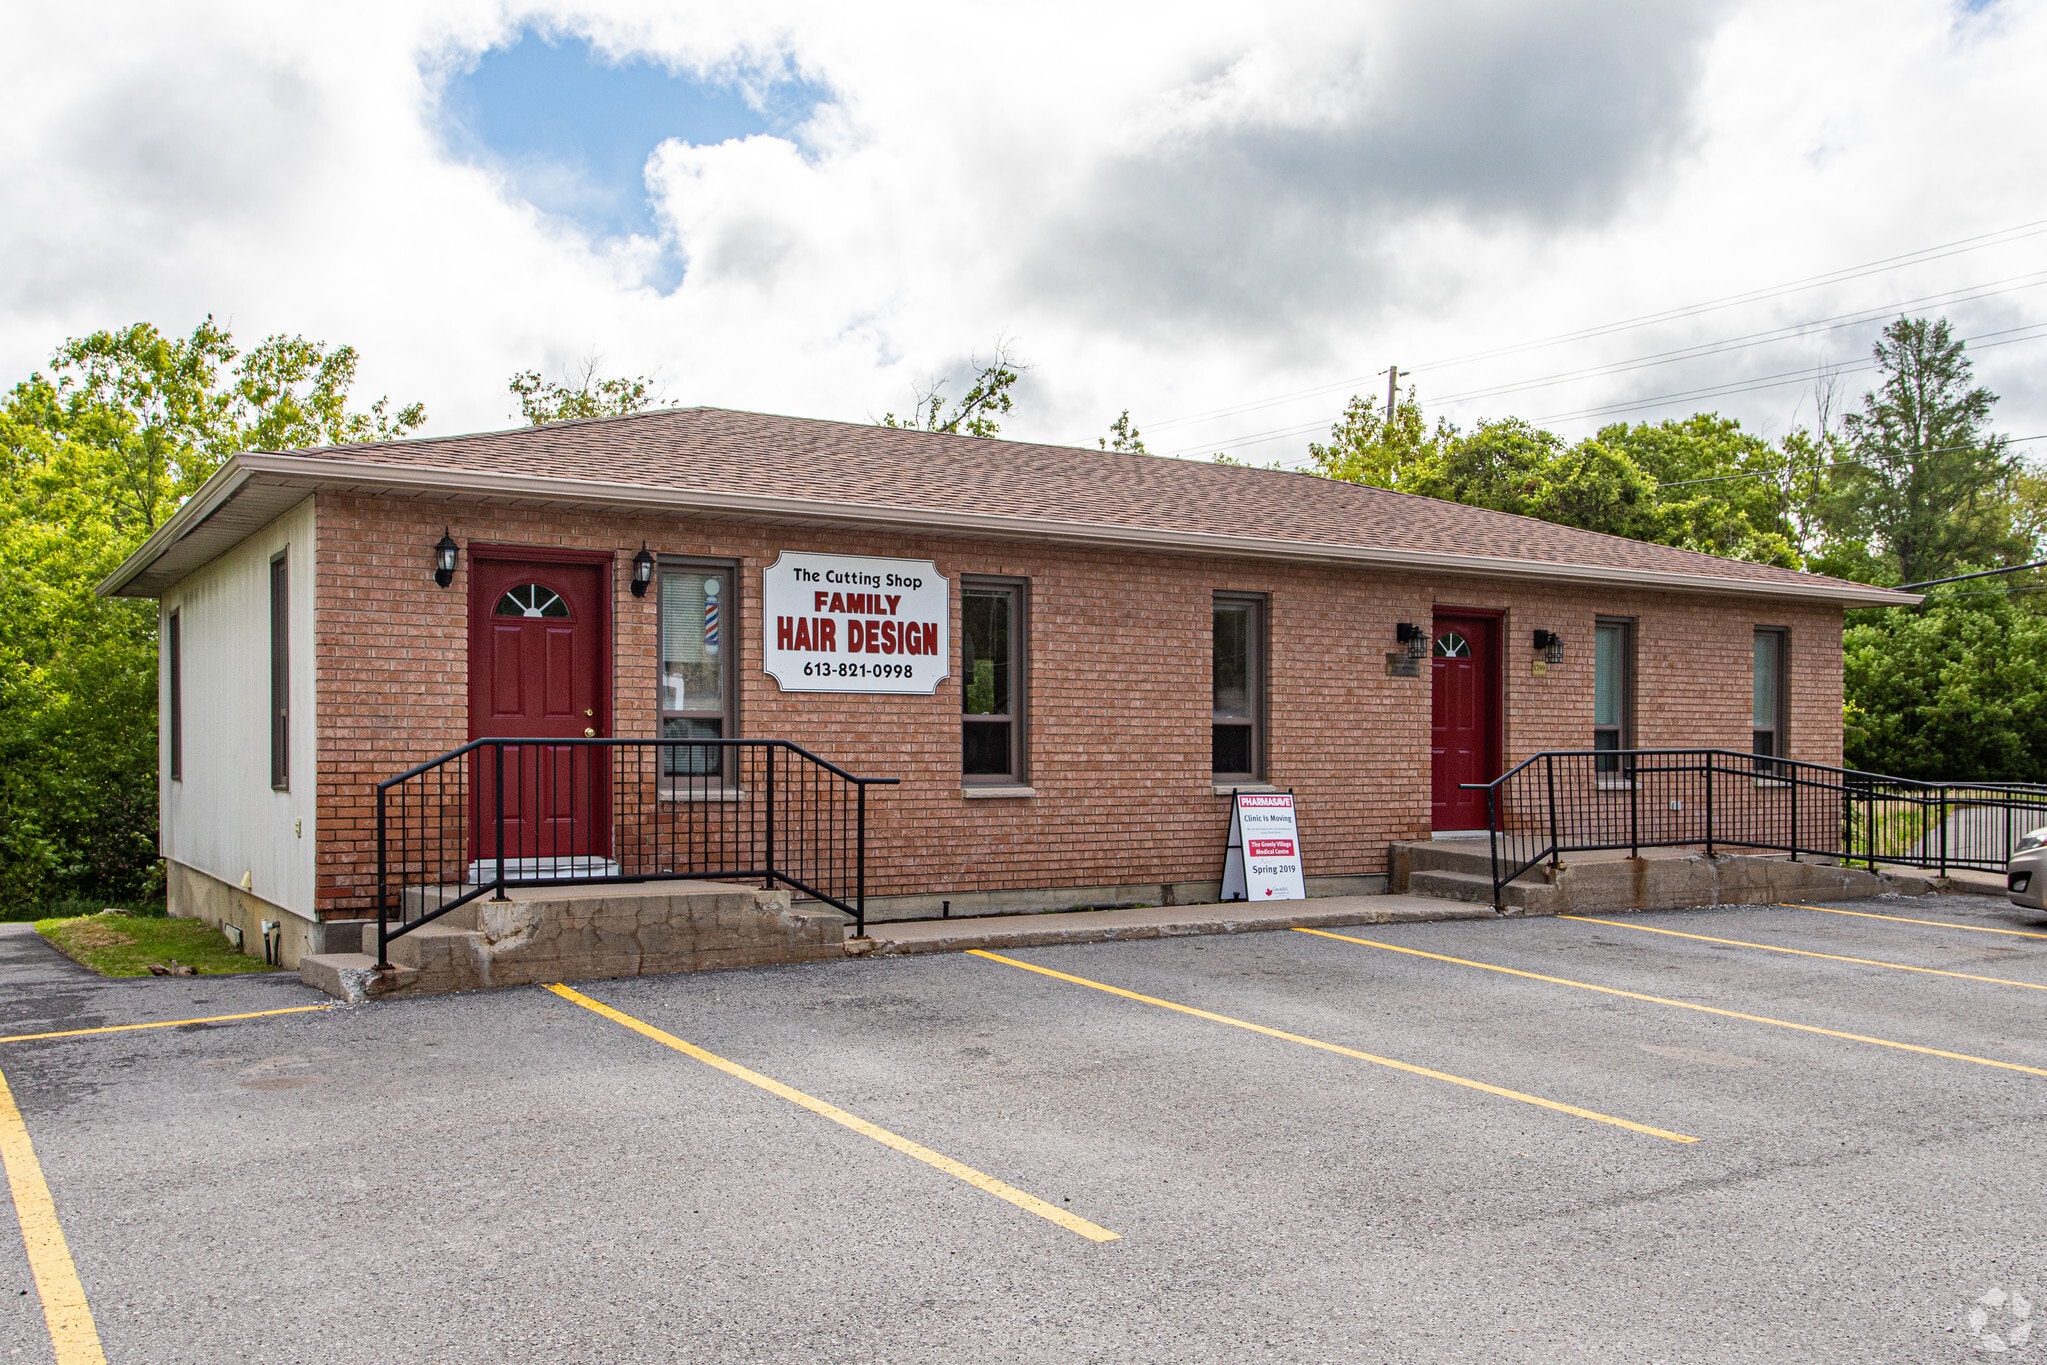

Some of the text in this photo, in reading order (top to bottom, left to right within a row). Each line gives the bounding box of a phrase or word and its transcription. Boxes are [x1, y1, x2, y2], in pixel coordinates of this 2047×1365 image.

[794, 568, 922, 590] The Cutting Shop
[814, 591, 901, 616] FAMILY
[777, 616, 938, 655] HAIR DESIGN
[803, 662, 913, 678] 613-821-0998
[1241, 797, 1291, 806] PHARMASAVE
[1270, 815, 1292, 823] Moving
[1252, 865, 1296, 875] Spring 2019
